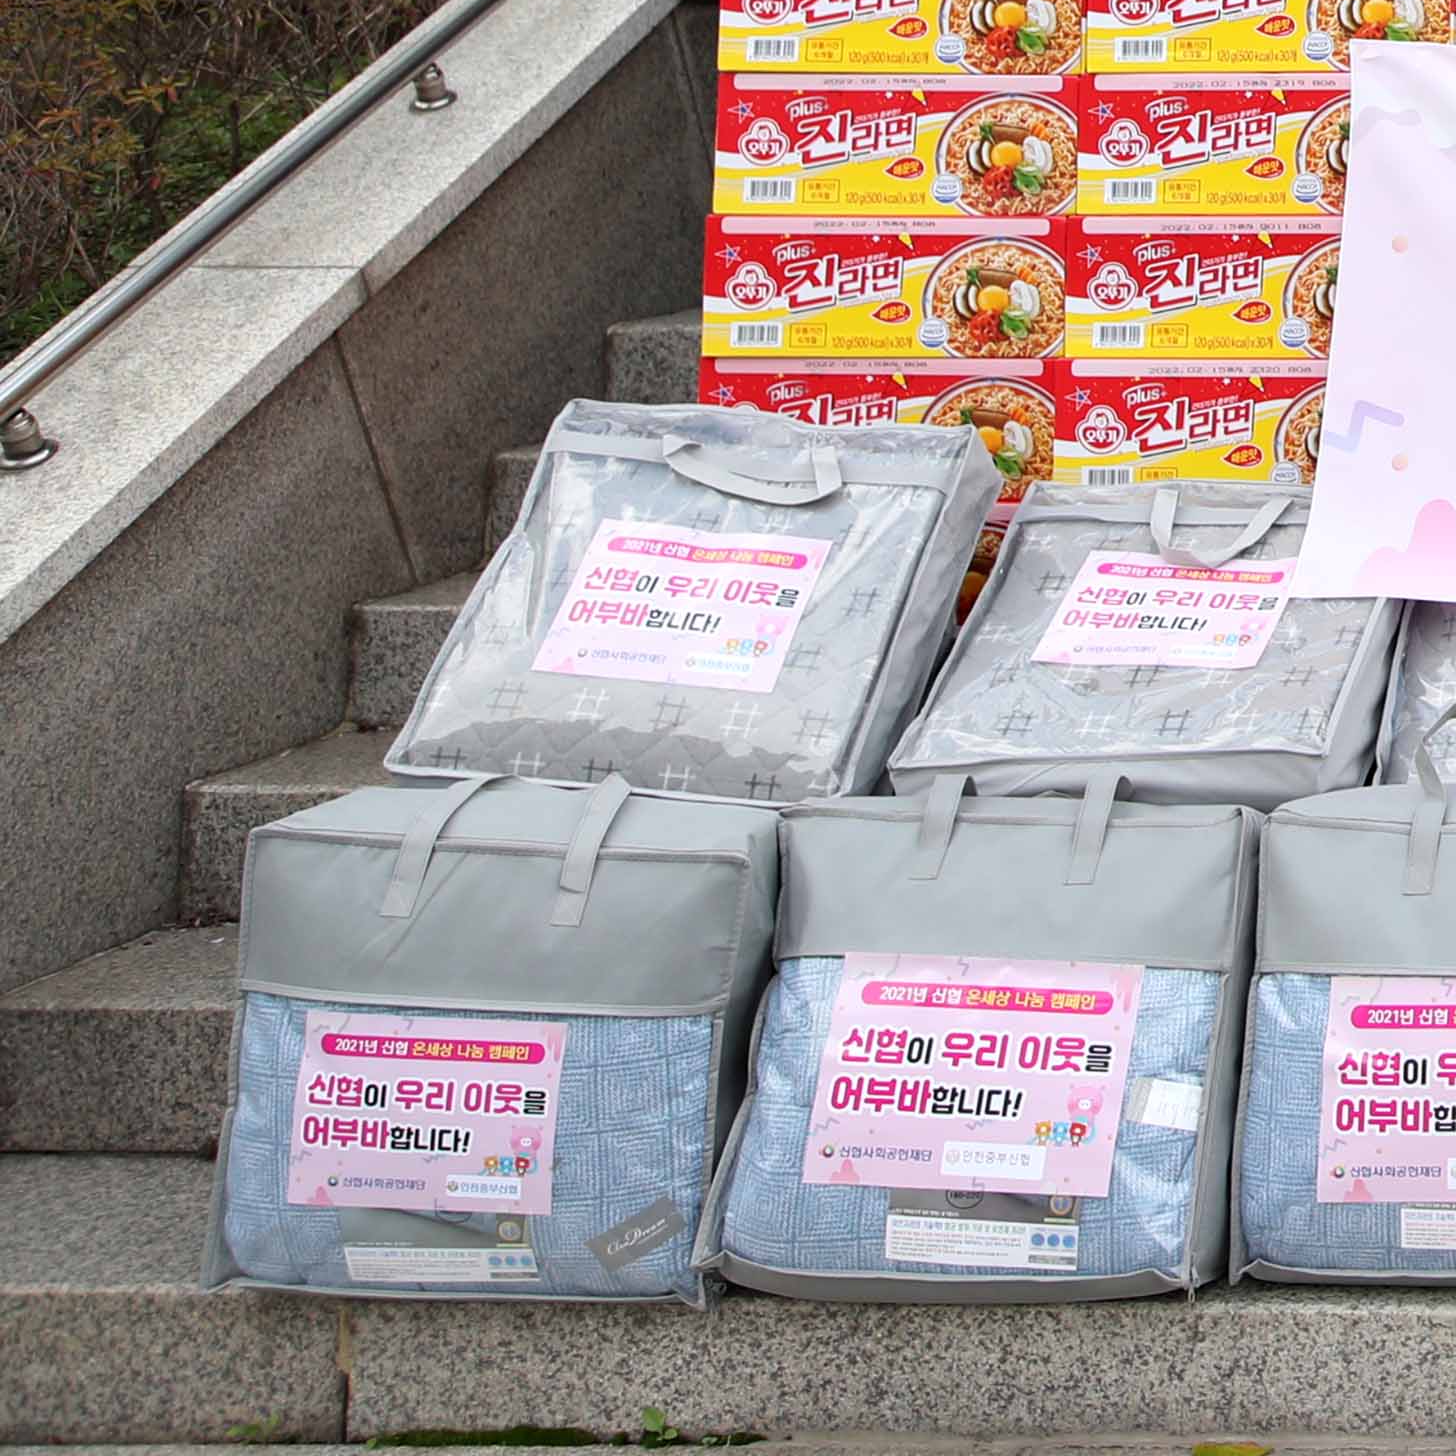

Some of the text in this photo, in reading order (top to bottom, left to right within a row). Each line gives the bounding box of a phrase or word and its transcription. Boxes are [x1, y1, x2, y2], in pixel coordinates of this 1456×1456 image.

[797, 112, 915, 165] 진라면
[1157, 112, 1275, 165] 진라면
[784, 256, 902, 309] 진라면
[1146, 256, 1261, 310] 진라면
[1135, 399, 1253, 453] 진라면
[880, 986, 927, 1003] 2021년
[931, 987, 962, 1005] 신협
[967, 988, 1010, 1007] 온세상
[1015, 991, 1044, 1008] 나눔
[1368, 1009, 1414, 1024] 2021년
[1419, 1008, 1448, 1025] 신협
[841, 1028, 1112, 1072] 신협이 우리 이웃을
[1338, 1051, 1427, 1087] 신협이
[307, 1074, 547, 1115] 신협이 우리 이웃을
[831, 1077, 1022, 1117] 어부바합니다!
[302, 1115, 470, 1153] 어부바합니다!
